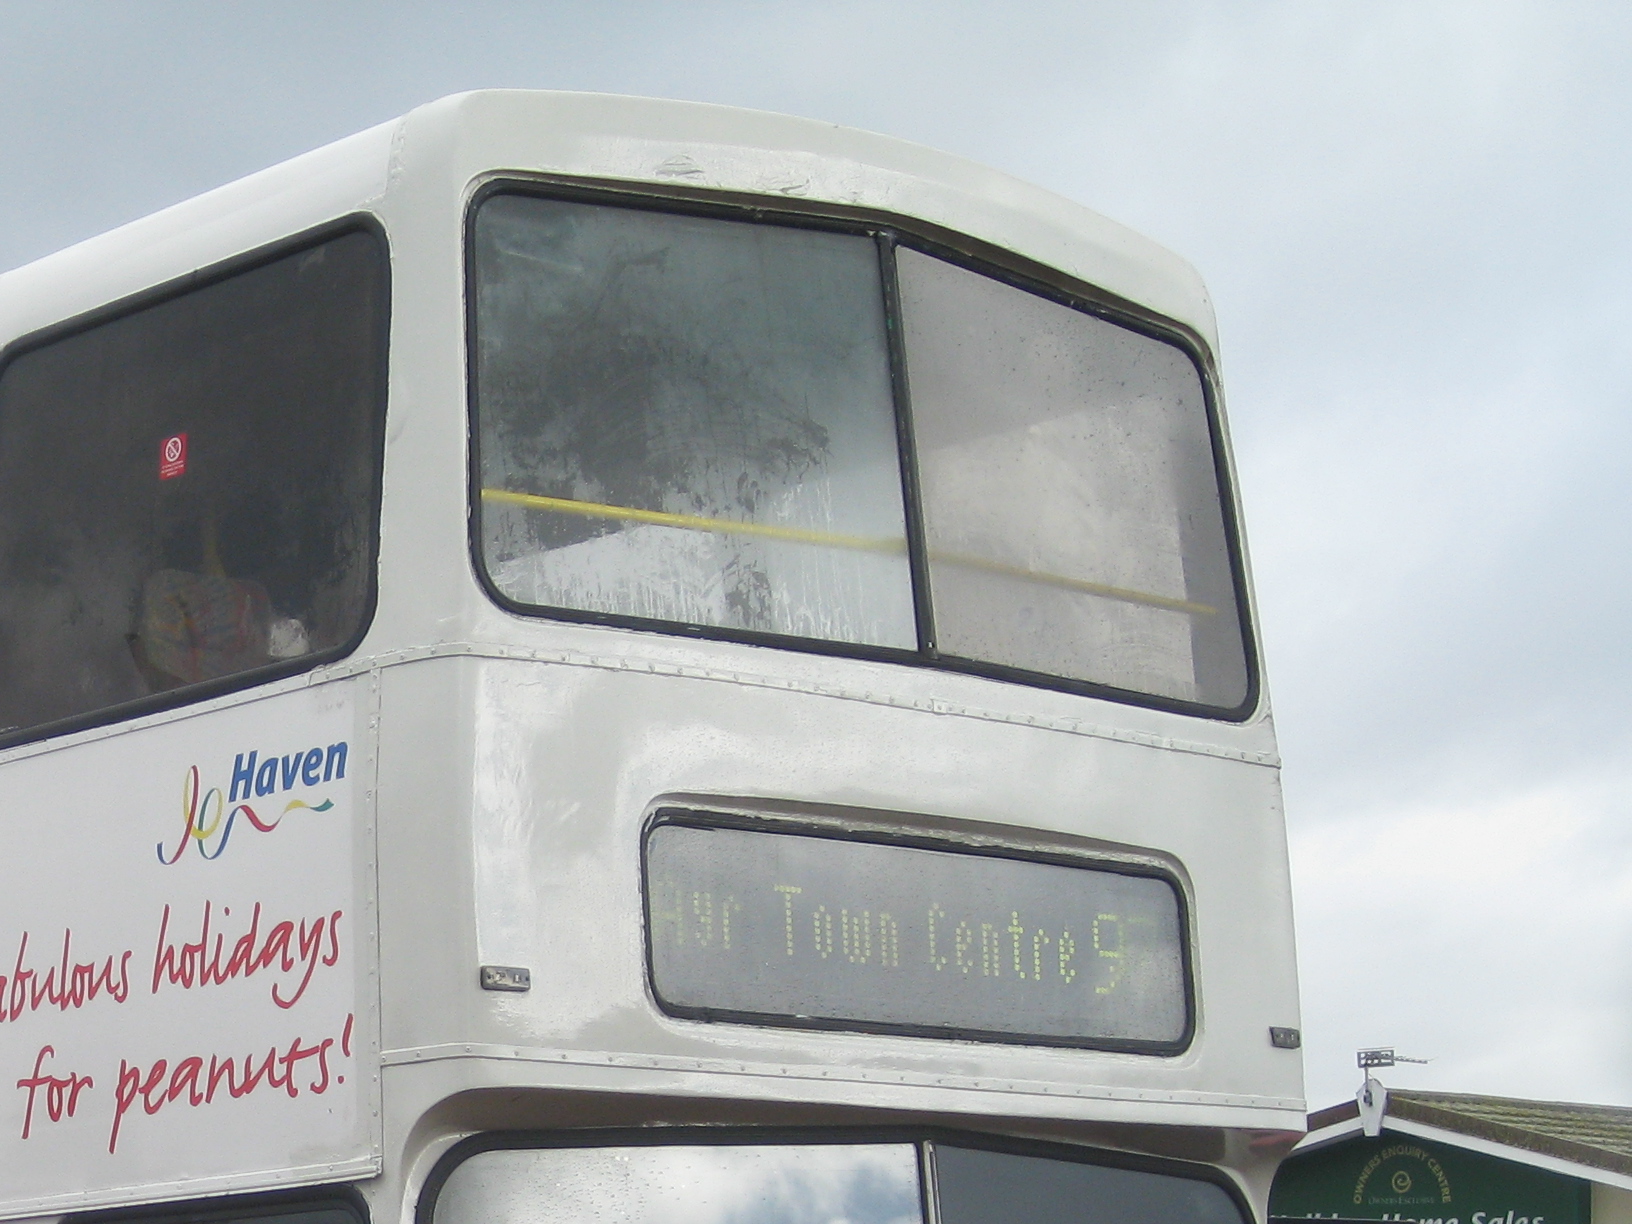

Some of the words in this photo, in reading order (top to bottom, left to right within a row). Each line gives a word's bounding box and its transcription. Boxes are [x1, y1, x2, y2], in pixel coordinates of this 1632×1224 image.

[228, 740, 349, 805] Haven
[152, 901, 343, 1009] holidays
[774, 884, 905, 968] Town
[928, 902, 1079, 984] Centre
[16, 1045, 93, 1140] for
[109, 1013, 353, 1155] peanuts!
[1353, 1154, 1382, 1204] OWNERS
[1381, 1145, 1428, 1161] ENQUIRY
[1427, 1158, 1451, 1204] CENTRE
